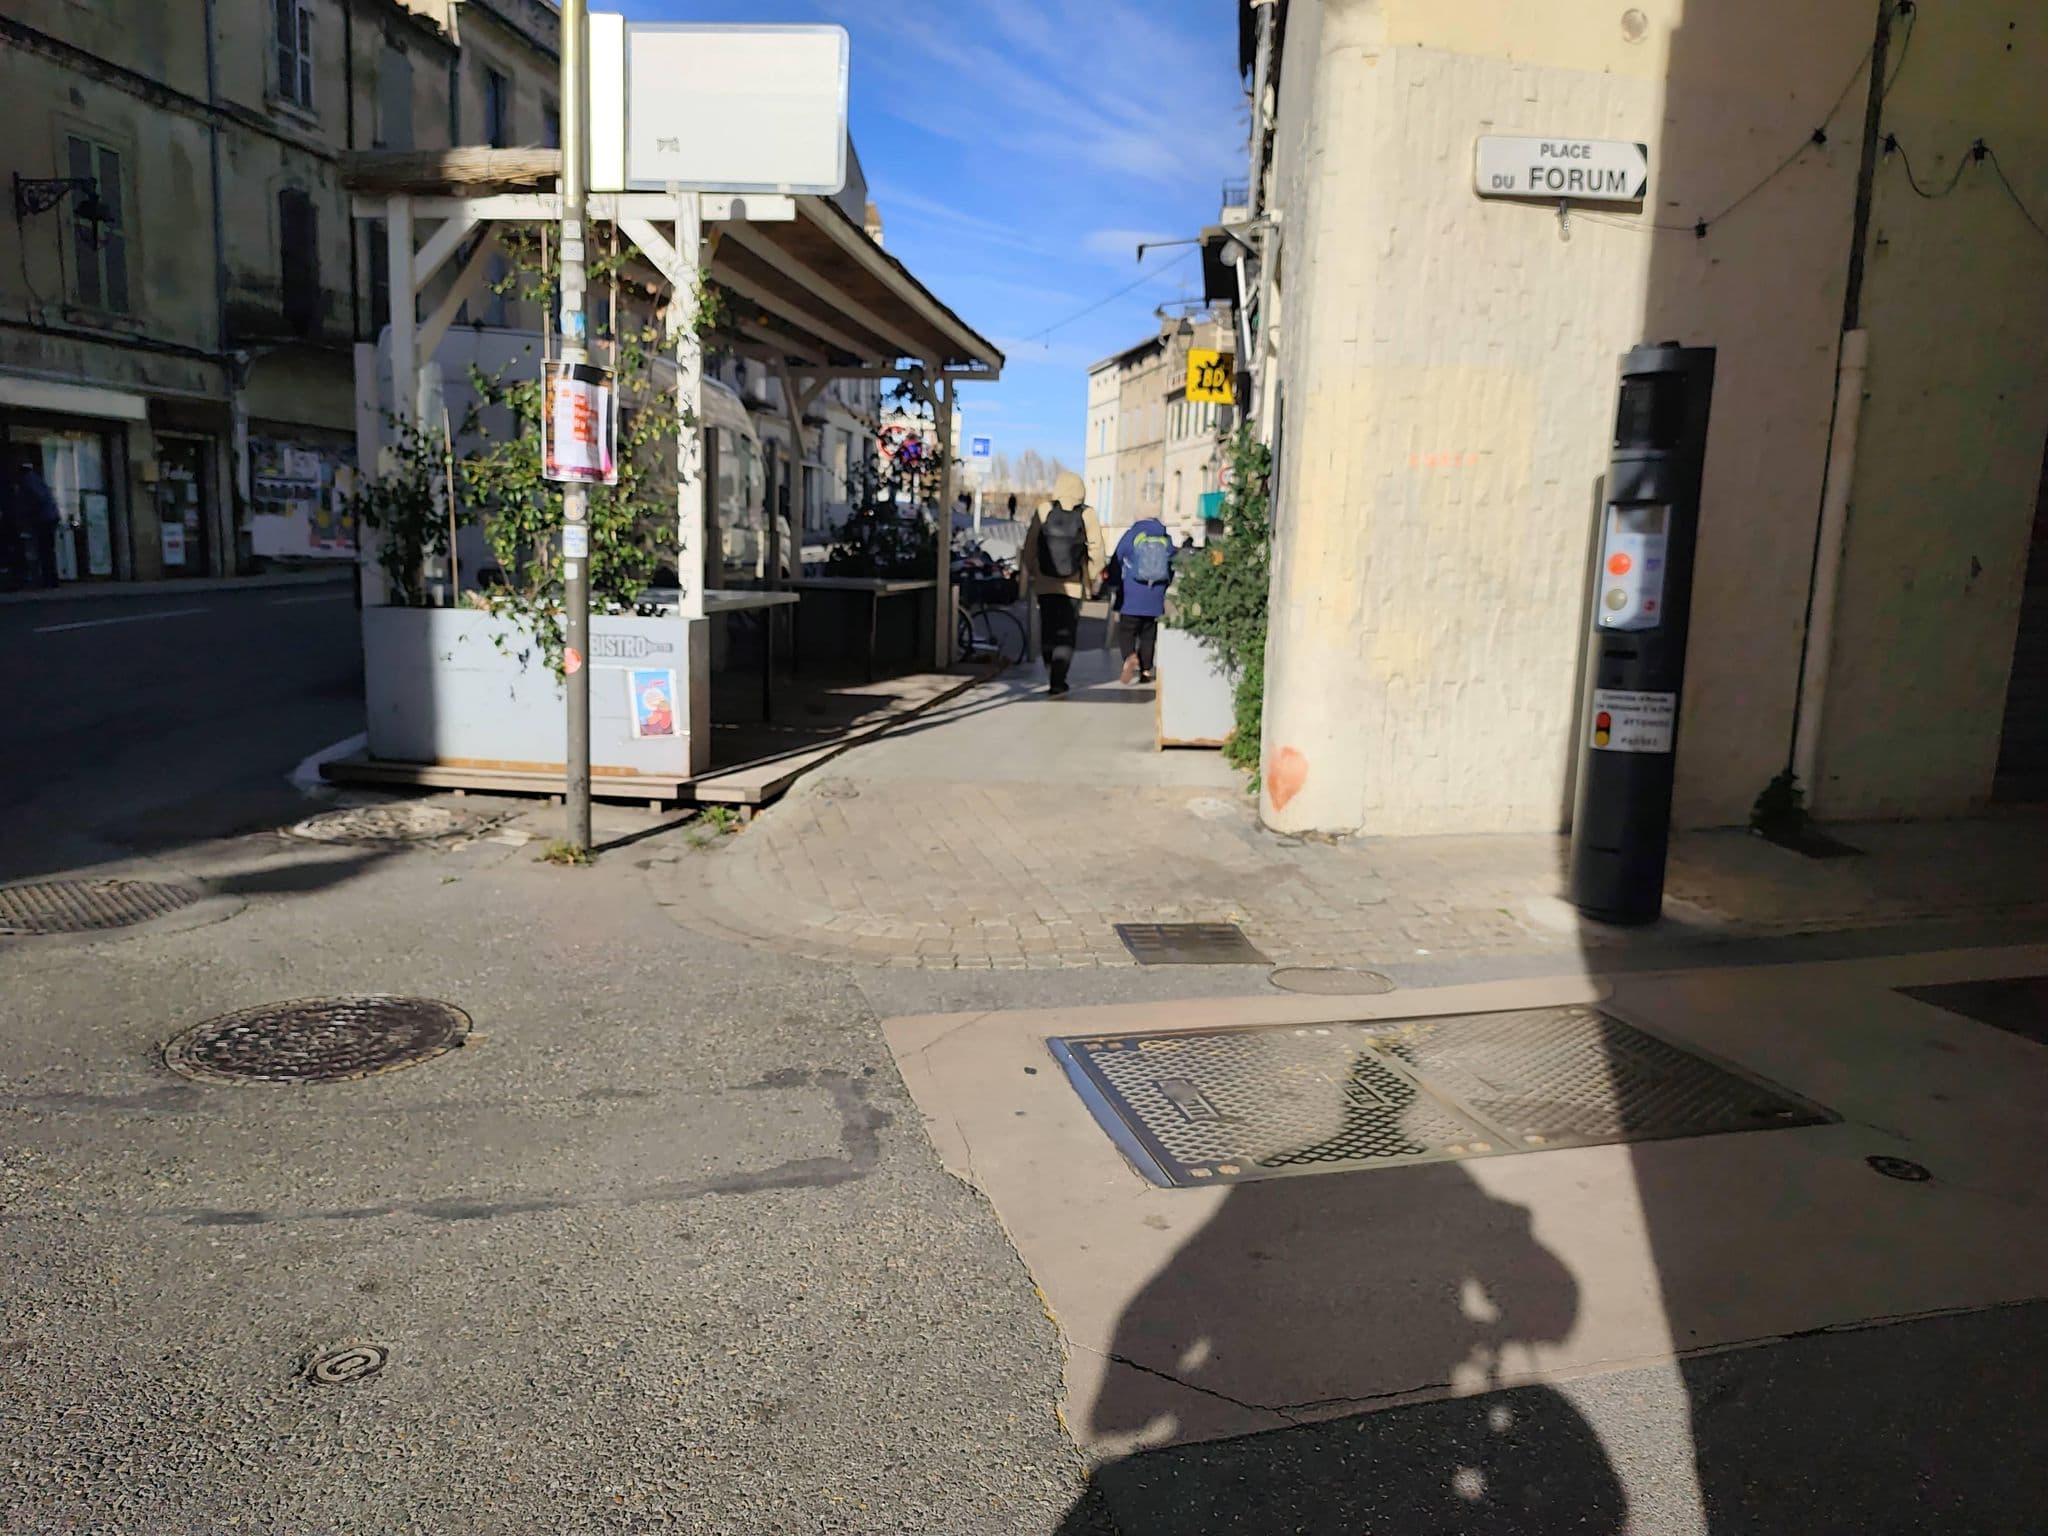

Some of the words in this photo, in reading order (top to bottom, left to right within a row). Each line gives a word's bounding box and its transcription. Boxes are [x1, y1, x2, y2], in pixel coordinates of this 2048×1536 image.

[1540, 143, 1592, 159] PLACE
[1491, 174, 1515, 189] DU
[1528, 166, 1627, 193] FORUM
[1202, 367, 1225, 387] BD
[590, 635, 648, 657] BISTRO
